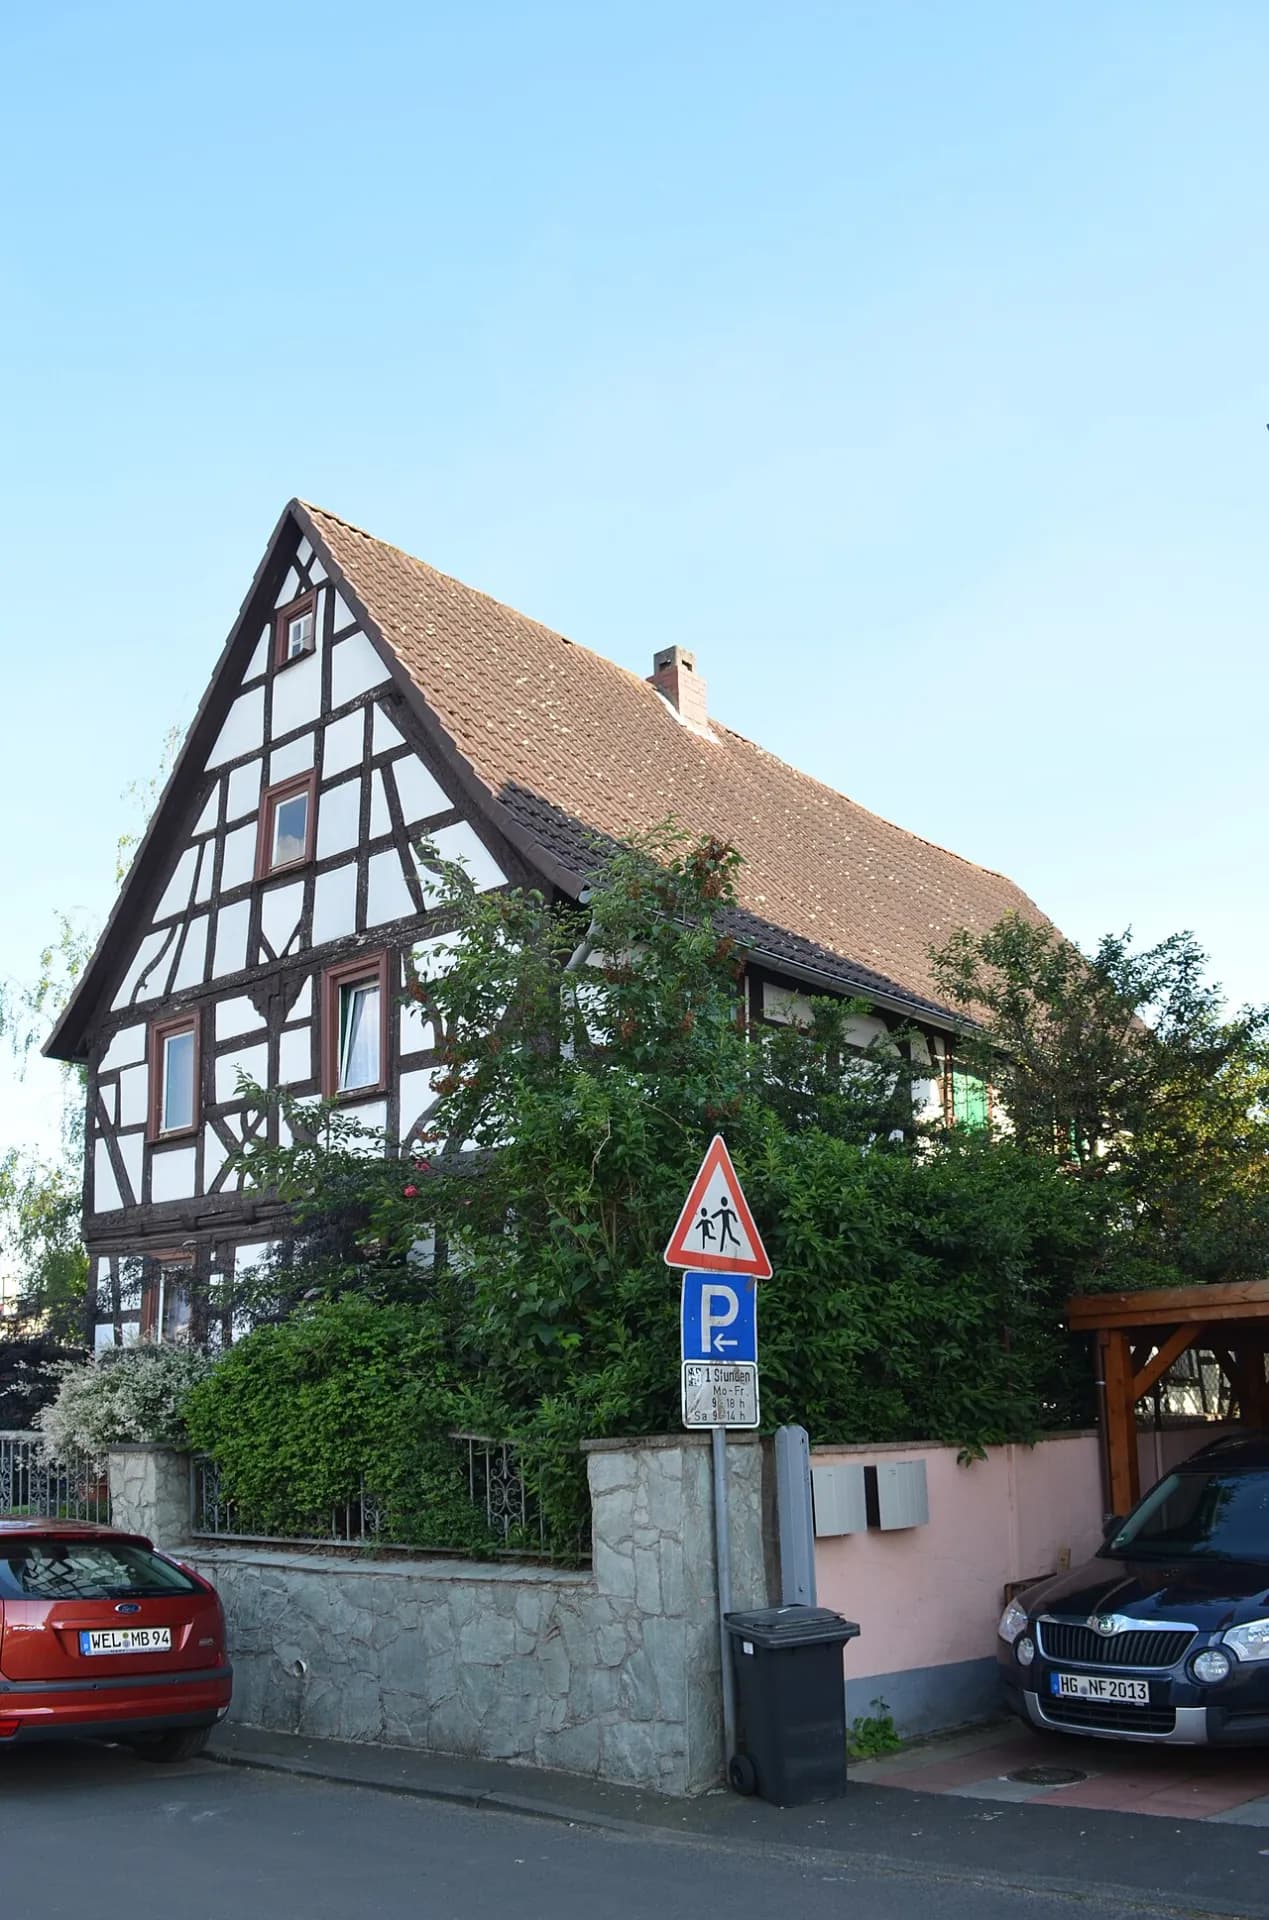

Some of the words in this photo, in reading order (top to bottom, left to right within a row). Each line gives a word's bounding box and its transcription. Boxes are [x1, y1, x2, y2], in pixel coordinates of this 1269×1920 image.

[701, 1284, 739, 1353] P
[706, 1368, 711, 1383] 1
[714, 1368, 751, 1383] Stunden
[694, 1410, 707, 1421] Sa
[91, 1632, 121, 1649] WEL
[1060, 1675, 1078, 1693] HG
